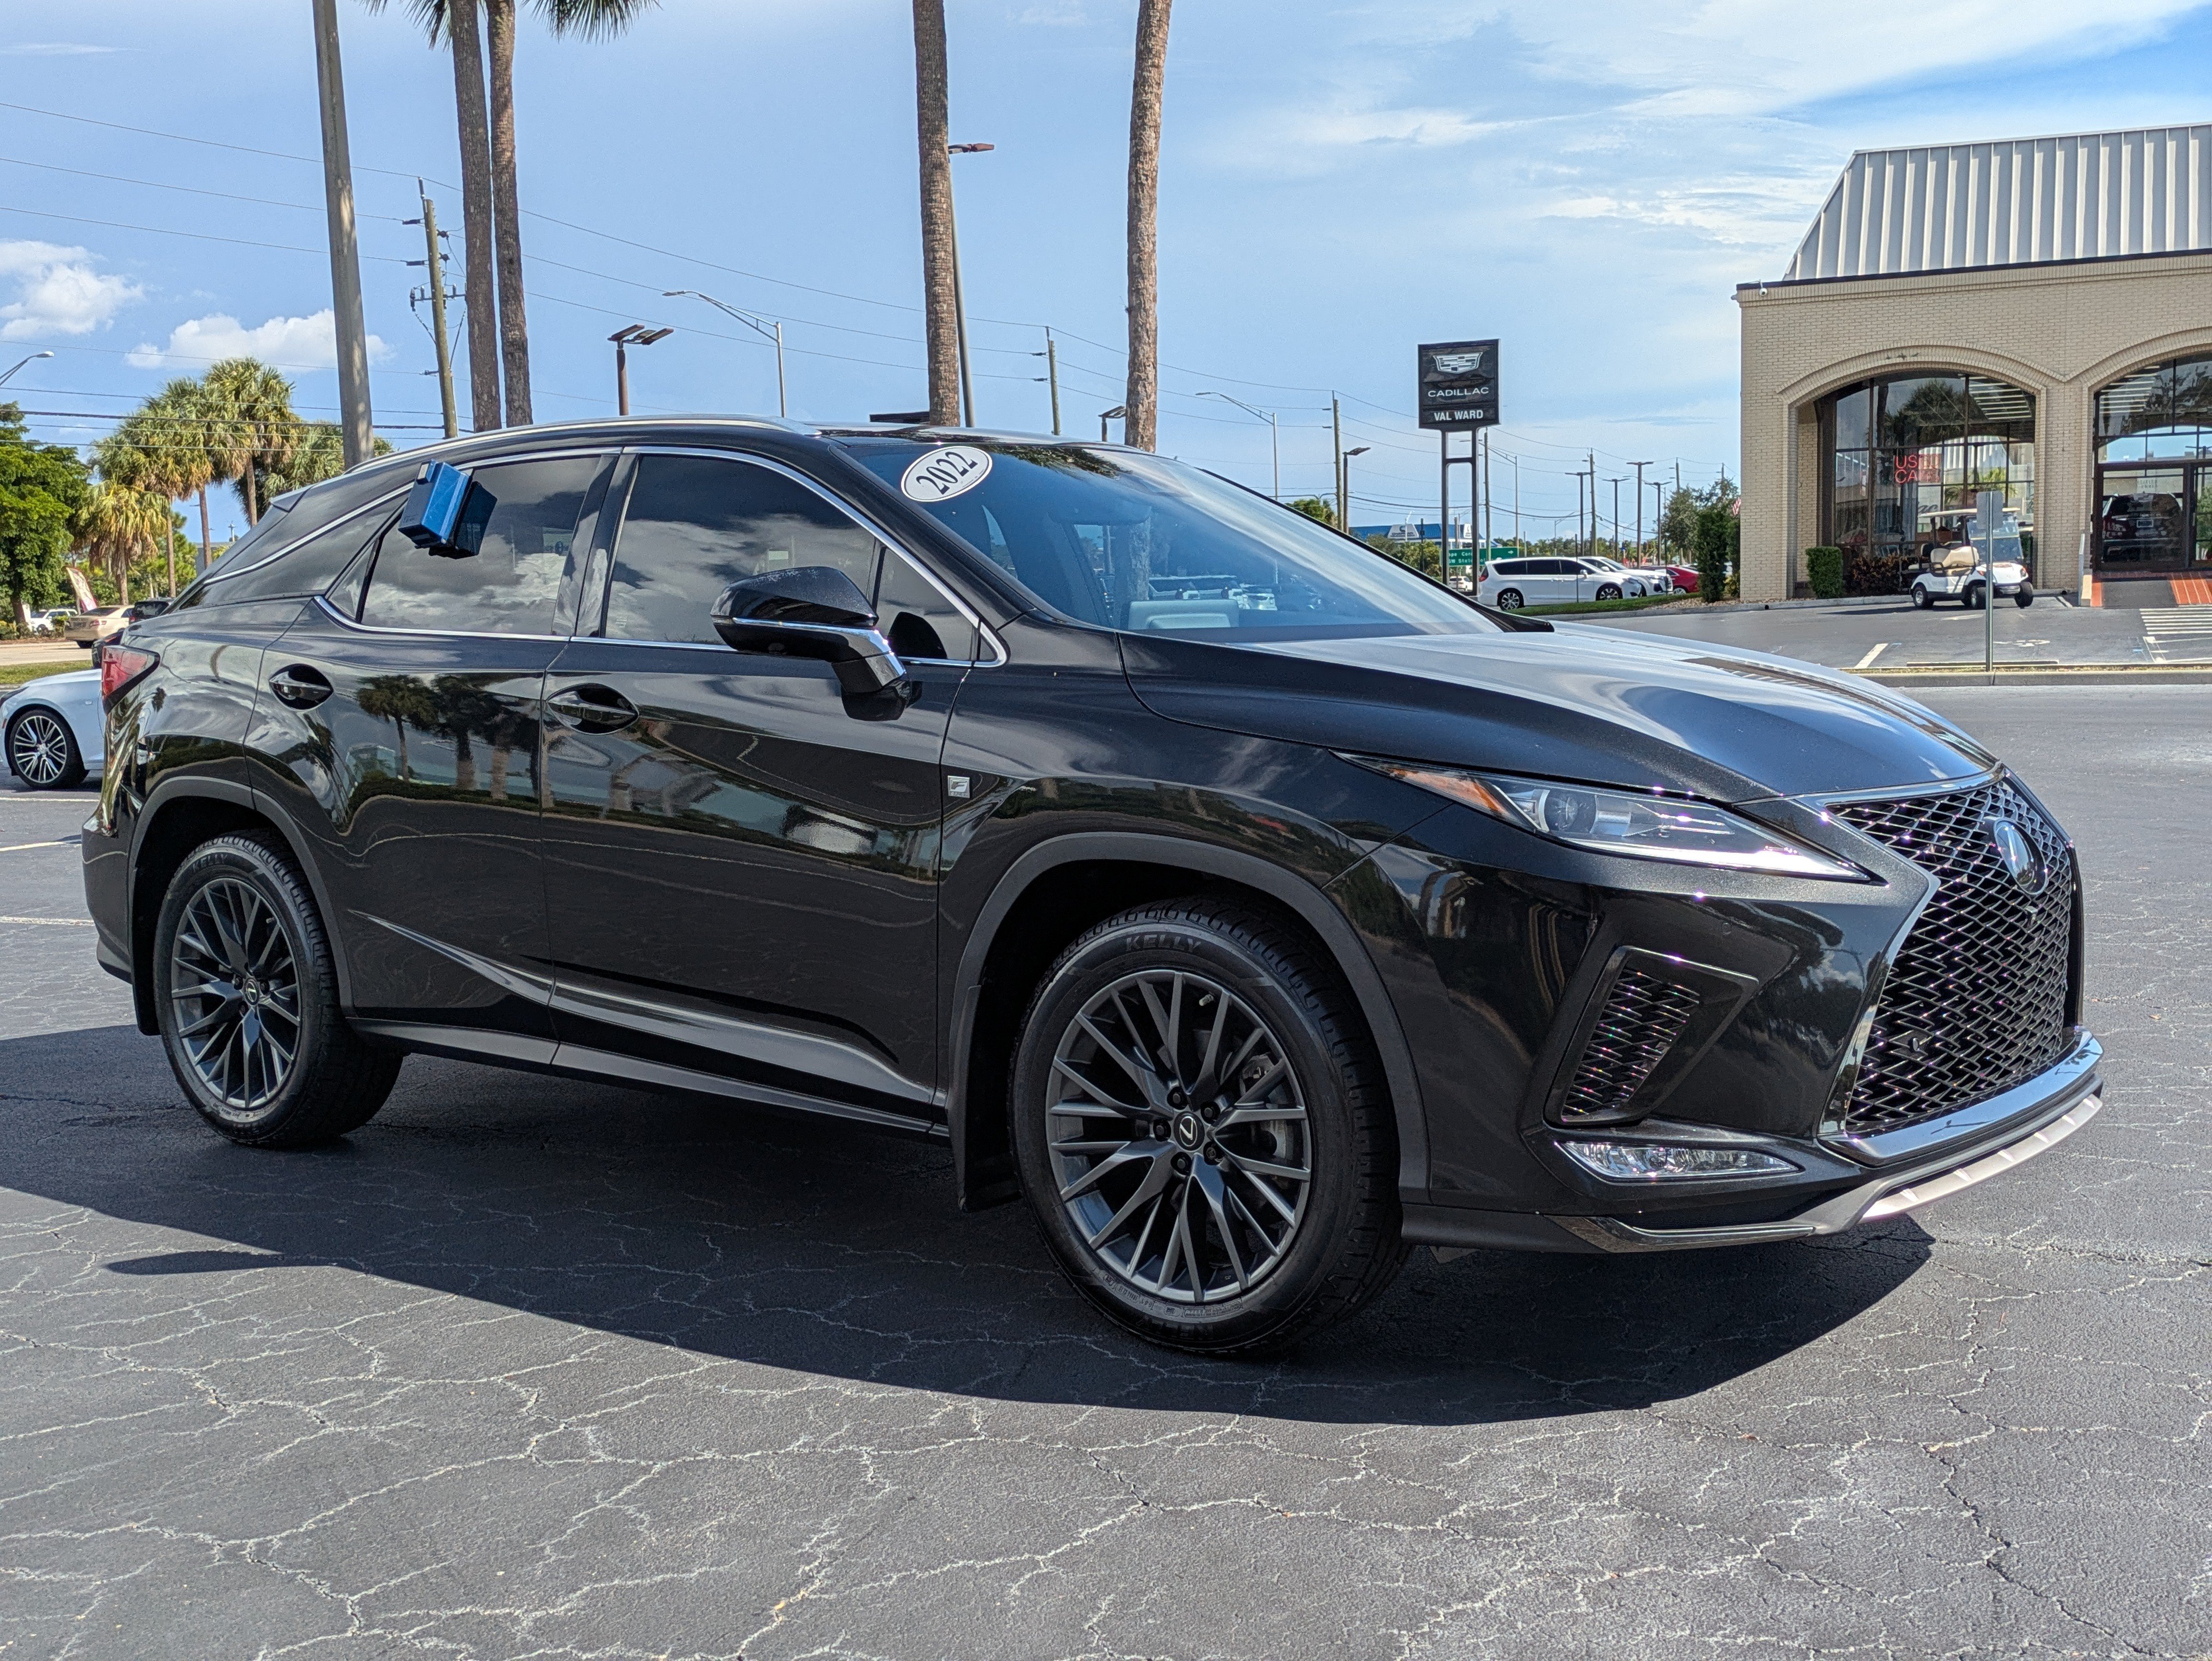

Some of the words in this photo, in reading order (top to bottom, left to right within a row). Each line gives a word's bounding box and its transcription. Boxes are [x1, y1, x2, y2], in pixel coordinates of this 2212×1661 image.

[1428, 387, 1489, 397] CADILLAC
[1434, 411, 1452, 421] VAL
[1454, 410, 1483, 420] WARD
[916, 451, 978, 495] 2022
[1126, 934, 1201, 952] KELLY
